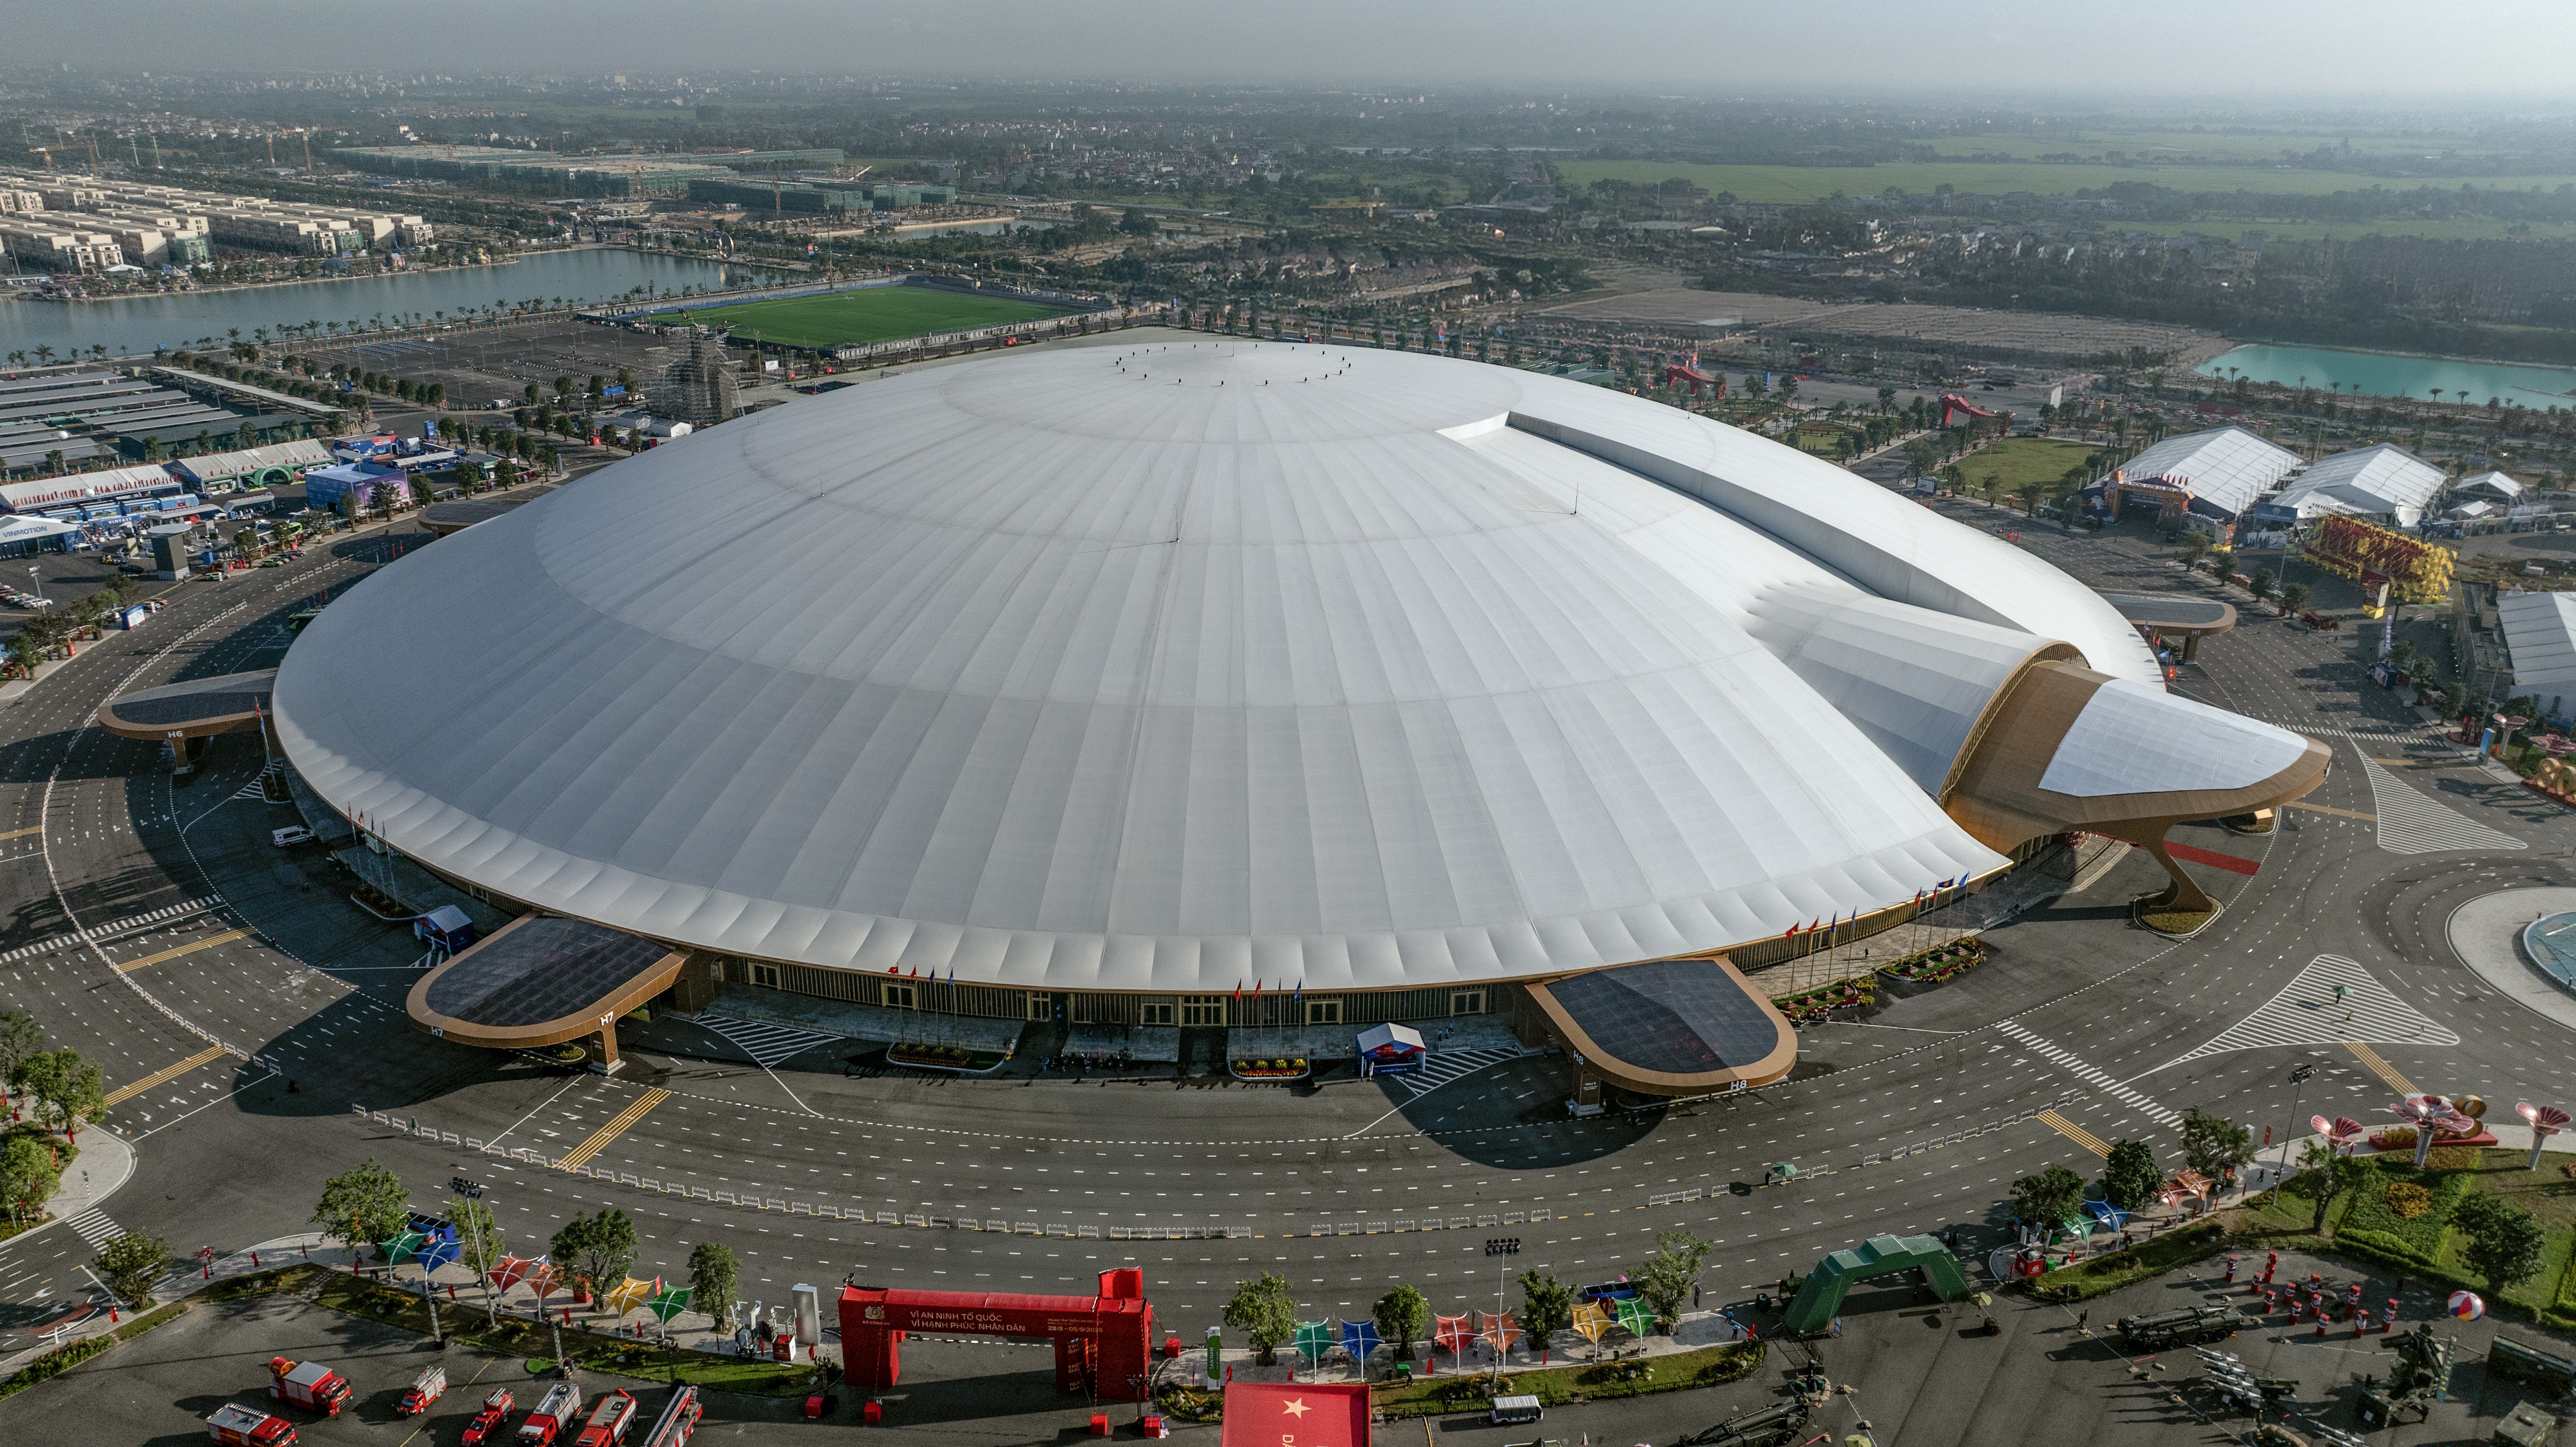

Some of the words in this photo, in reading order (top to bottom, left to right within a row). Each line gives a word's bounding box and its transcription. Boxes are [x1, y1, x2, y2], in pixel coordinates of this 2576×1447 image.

[2, 526, 47, 537] VINMOTION
[600, 1011, 614, 1026] H7
[431, 1026, 444, 1037] H7
[1573, 1050, 1584, 1065] H8
[1730, 1080, 1747, 1090] H8
[975, 1313, 1002, 1321] QUỐC
[922, 1320, 948, 1329] HẠNH
